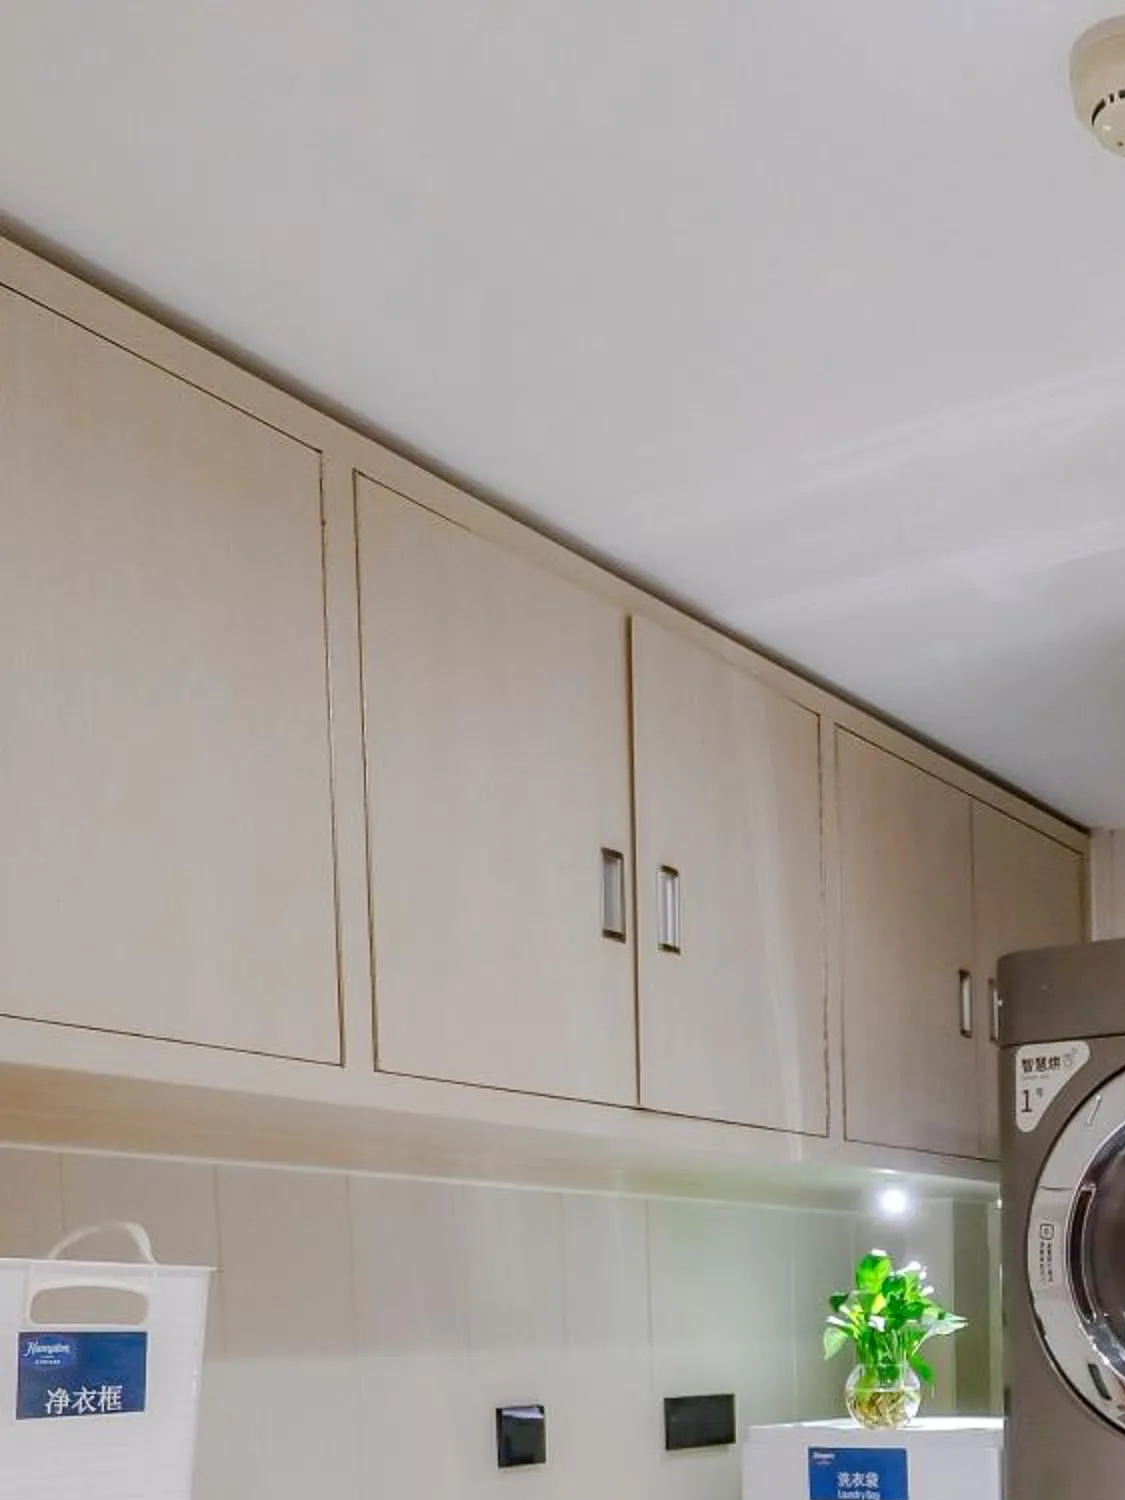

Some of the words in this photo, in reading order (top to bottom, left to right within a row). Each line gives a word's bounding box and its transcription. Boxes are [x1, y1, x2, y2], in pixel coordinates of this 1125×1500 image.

[1022, 1055, 1061, 1073] 智慧烘
[22, 1341, 71, 1357] Hampton
[45, 1385, 123, 1415] 净衣框
[837, 1471, 879, 1489] 洗衣袋
